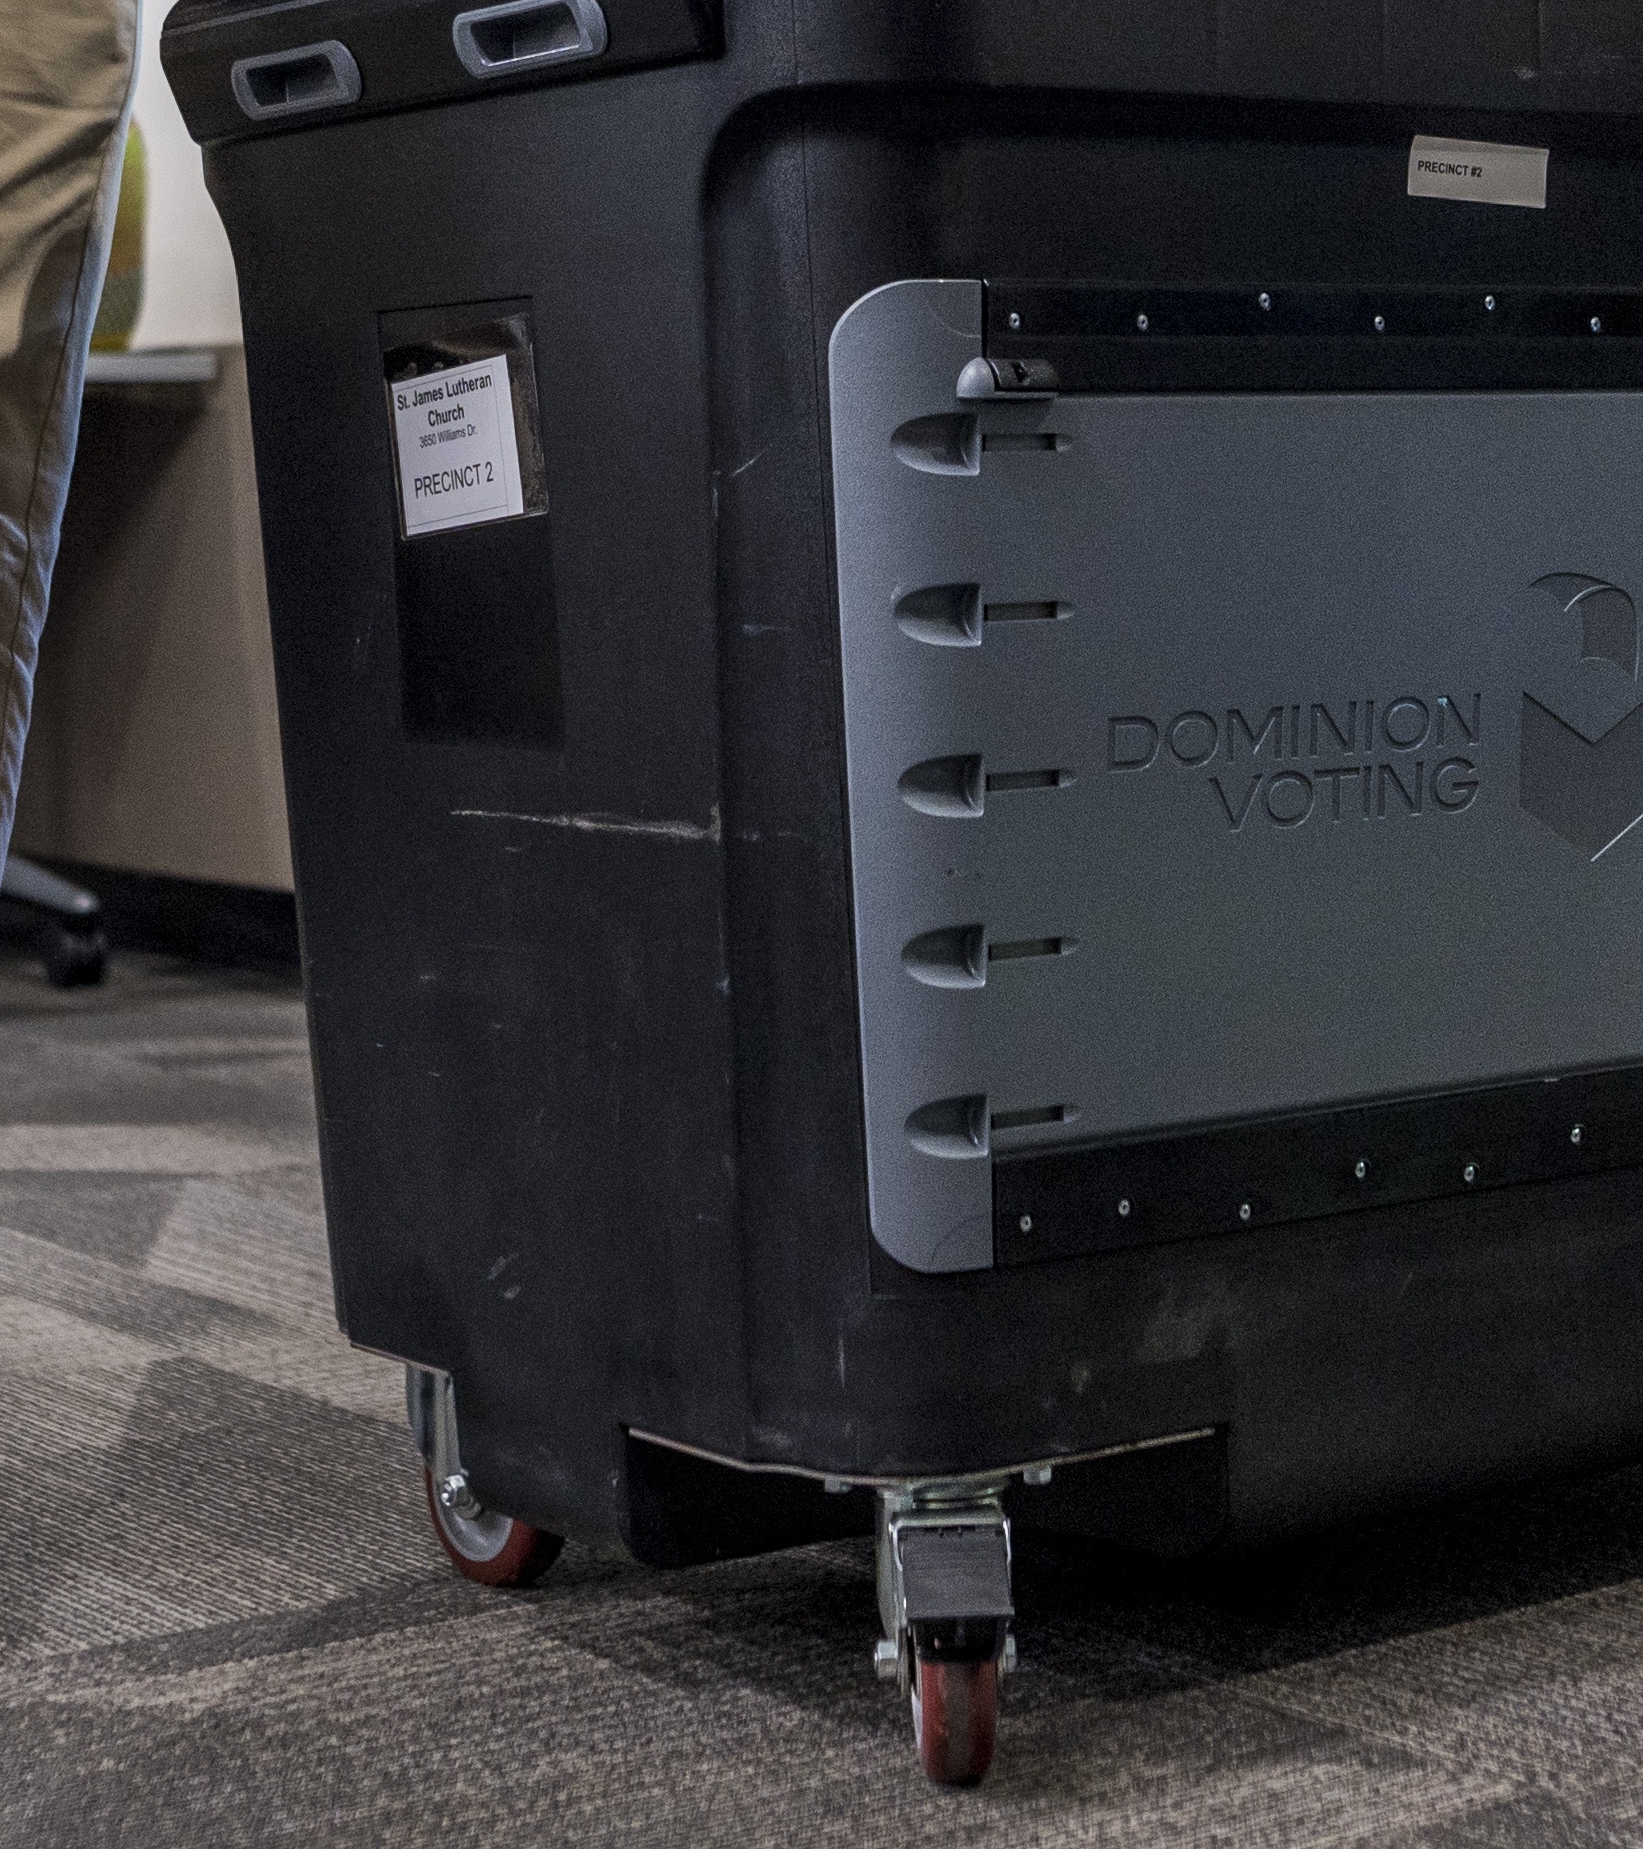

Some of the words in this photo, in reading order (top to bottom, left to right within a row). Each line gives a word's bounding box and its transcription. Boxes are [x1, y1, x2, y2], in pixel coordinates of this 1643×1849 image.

[1417, 160, 1469, 177] PRECINCT
[1470, 166, 1483, 178] #2
[397, 394, 411, 411] St.
[412, 387, 444, 407] James
[445, 374, 492, 397] Lutheran
[427, 403, 465, 427] Church
[419, 433, 437, 449] 3650
[437, 428, 467, 444] Williams
[466, 423, 478, 438] Dr.
[414, 463, 481, 499] PRECINCT
[485, 461, 495, 483] 2
[1106, 692, 1483, 775] DOMINION
[1208, 757, 1482, 834] VOTING
